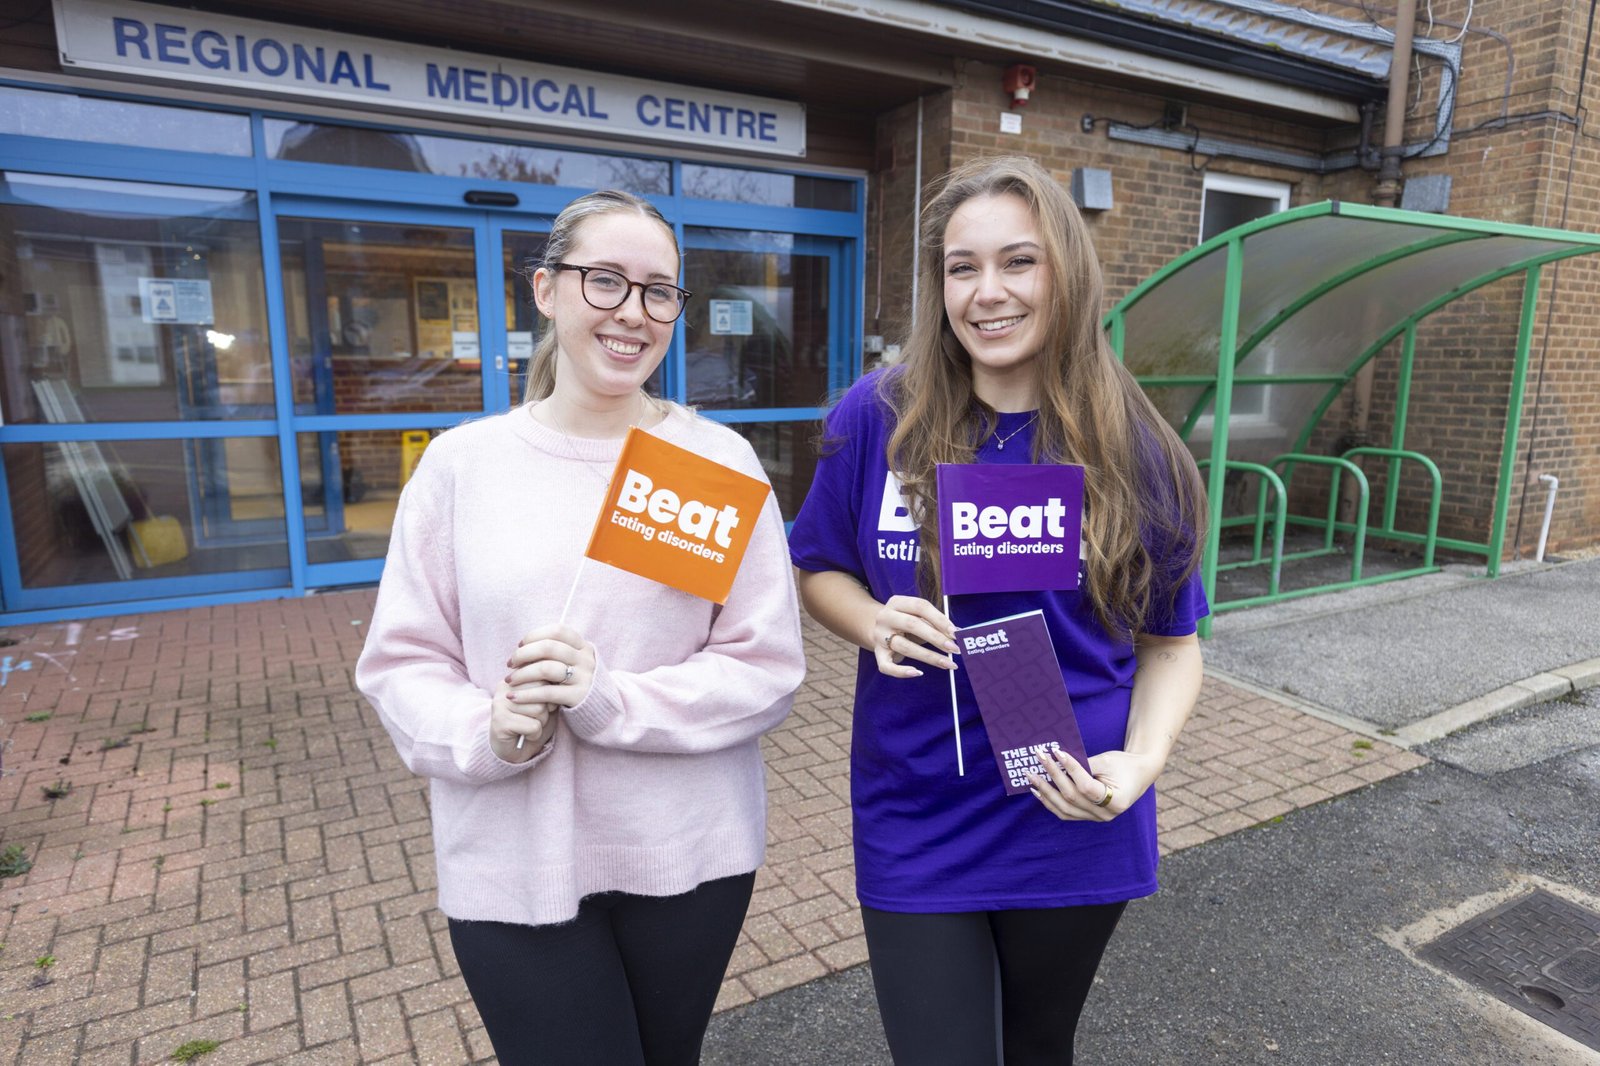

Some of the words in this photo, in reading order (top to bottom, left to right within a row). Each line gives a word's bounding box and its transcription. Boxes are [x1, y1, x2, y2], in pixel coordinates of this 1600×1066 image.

[112, 17, 391, 92] REGIONAL
[425, 62, 609, 120] MEDICAL
[636, 94, 778, 143] CENTRE
[616, 469, 740, 549] Beat
[951, 497, 1066, 540] Beat
[611, 510, 656, 541] Eating
[657, 530, 726, 564] disorders
[877, 538, 922, 562] Eati
[953, 541, 994, 559] Eating
[997, 541, 1064, 555] disorders
[963, 629, 1009, 650] Beat
[985, 643, 1010, 651] disorders
[1001, 747, 1028, 759] THE
[1028, 741, 1060, 754] UK'S
[1004, 755, 1041, 769] EATI
